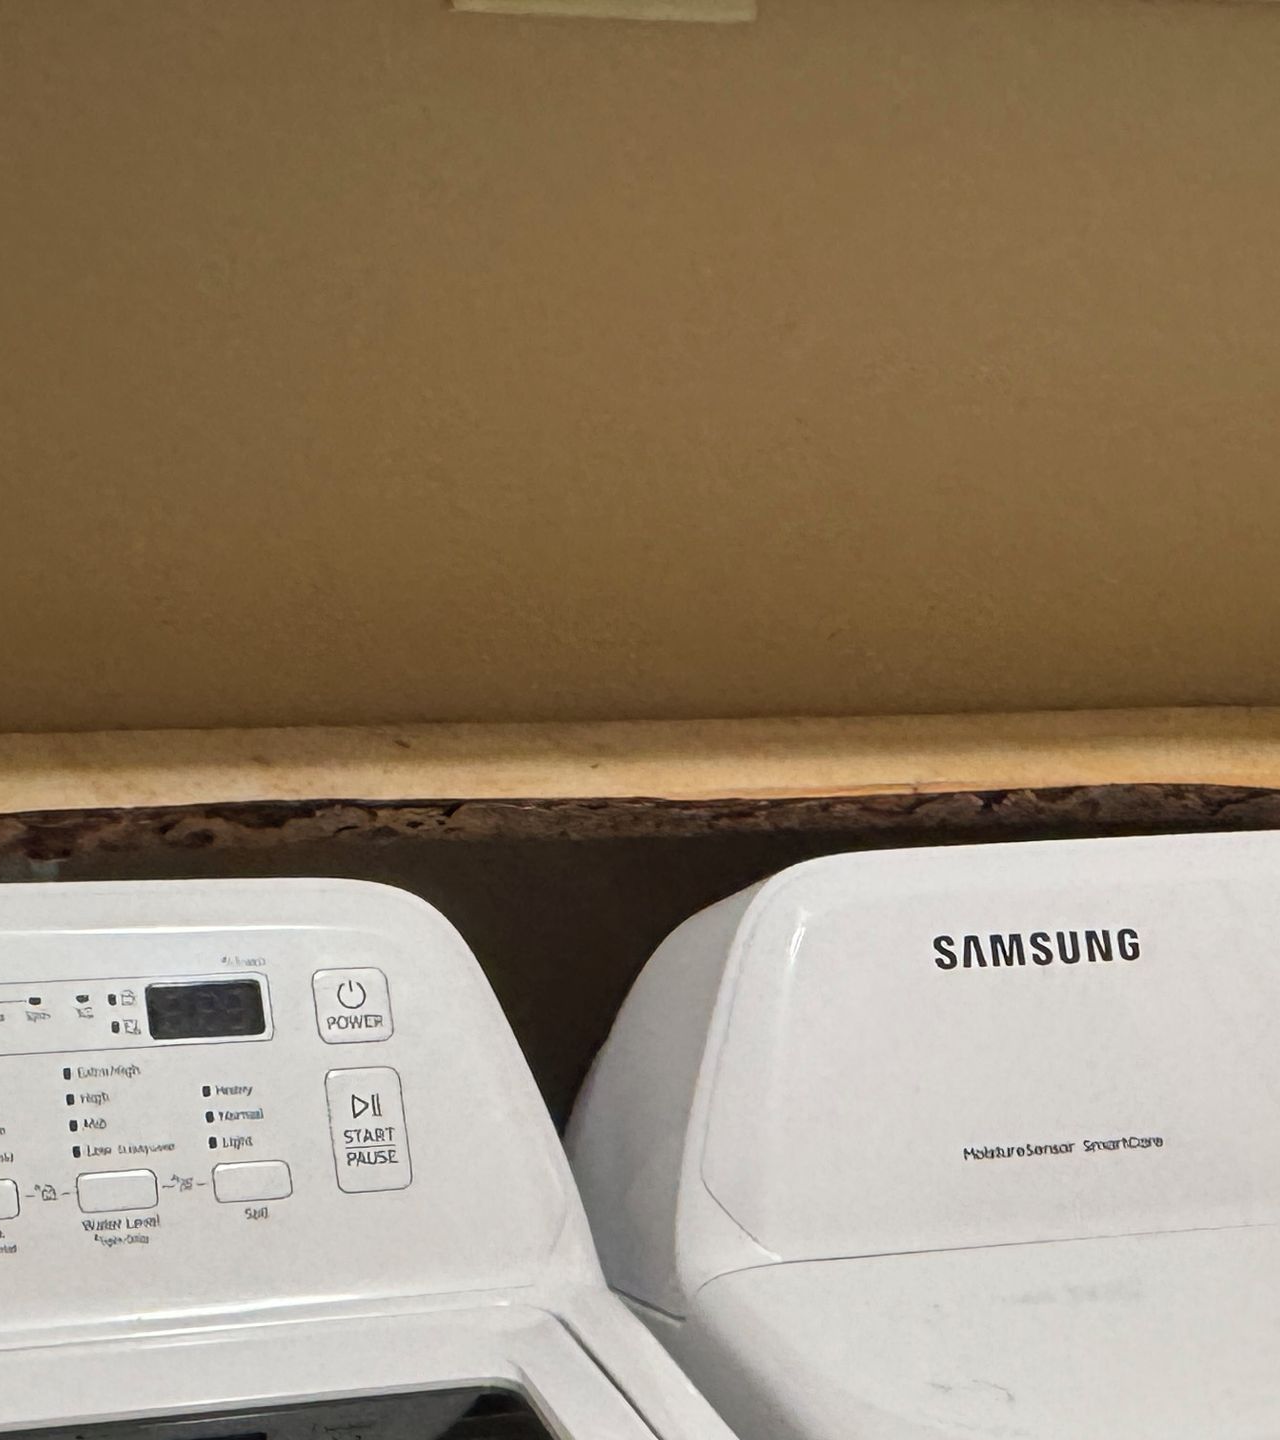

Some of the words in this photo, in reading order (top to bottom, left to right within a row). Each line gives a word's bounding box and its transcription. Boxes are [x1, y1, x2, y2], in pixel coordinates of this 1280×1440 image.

[933, 928, 1141, 969] SAMSUNG
[327, 1014, 383, 1030] POWER
[343, 1127, 395, 1144] START
[347, 1150, 399, 1167] PAUSE
